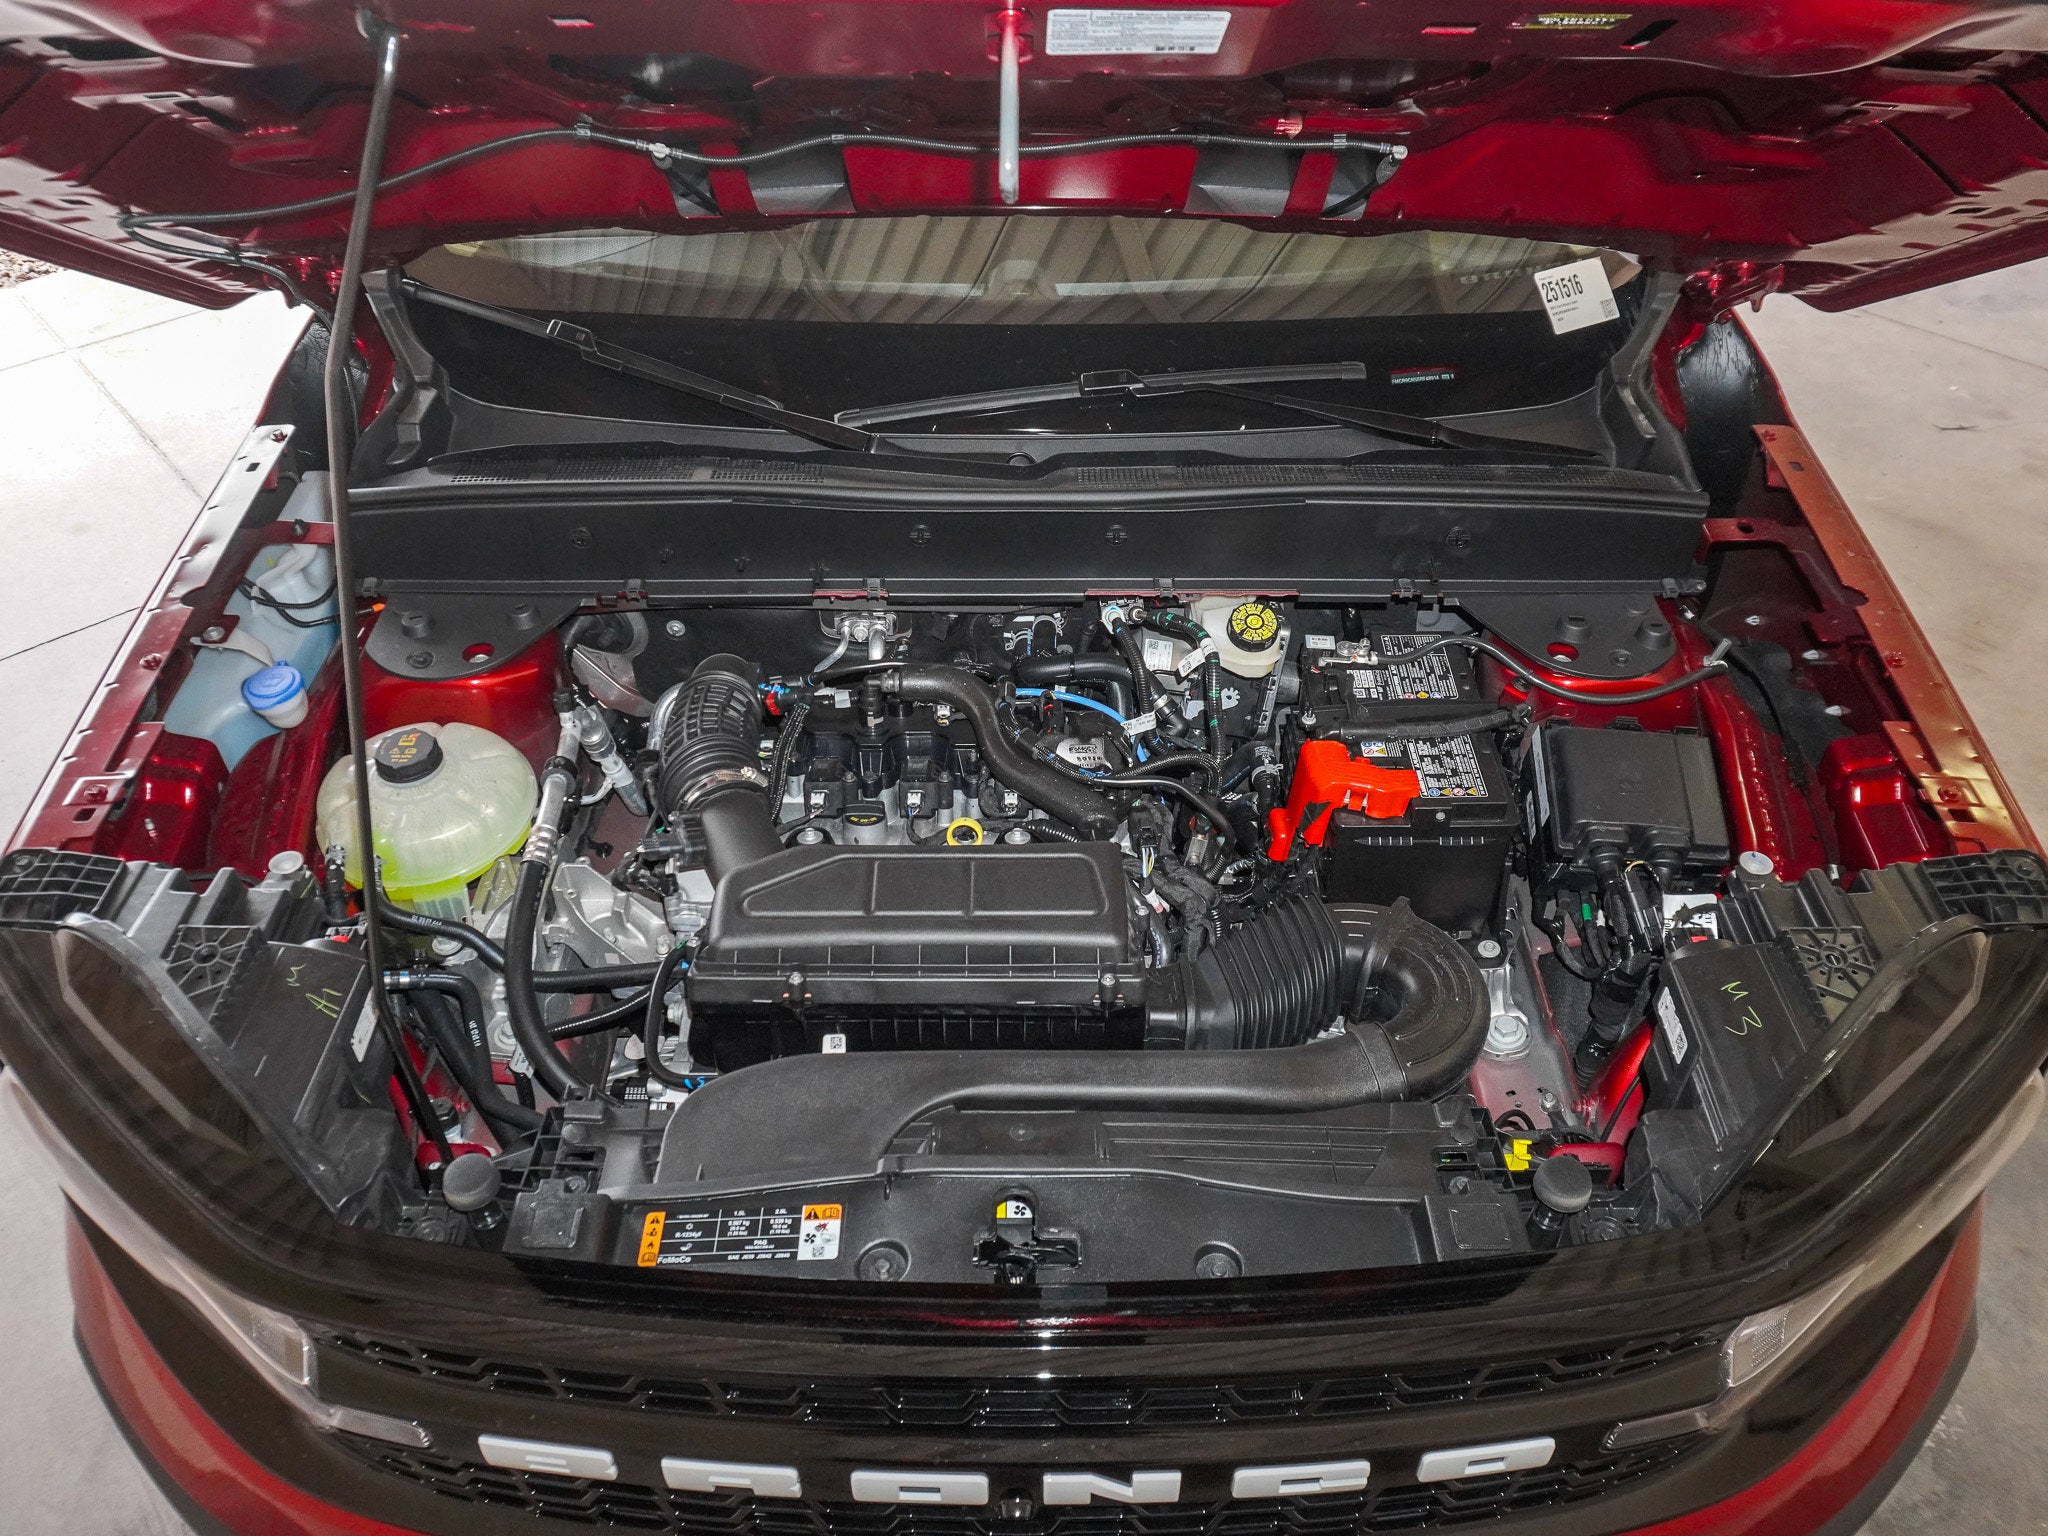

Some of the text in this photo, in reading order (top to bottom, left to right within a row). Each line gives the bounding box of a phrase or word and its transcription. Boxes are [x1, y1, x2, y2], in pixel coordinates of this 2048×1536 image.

[1542, 274, 1583, 303] 251516
[657, 1256, 691, 1264] FoMoCo
[477, 1433, 1556, 1505] BRONCO
